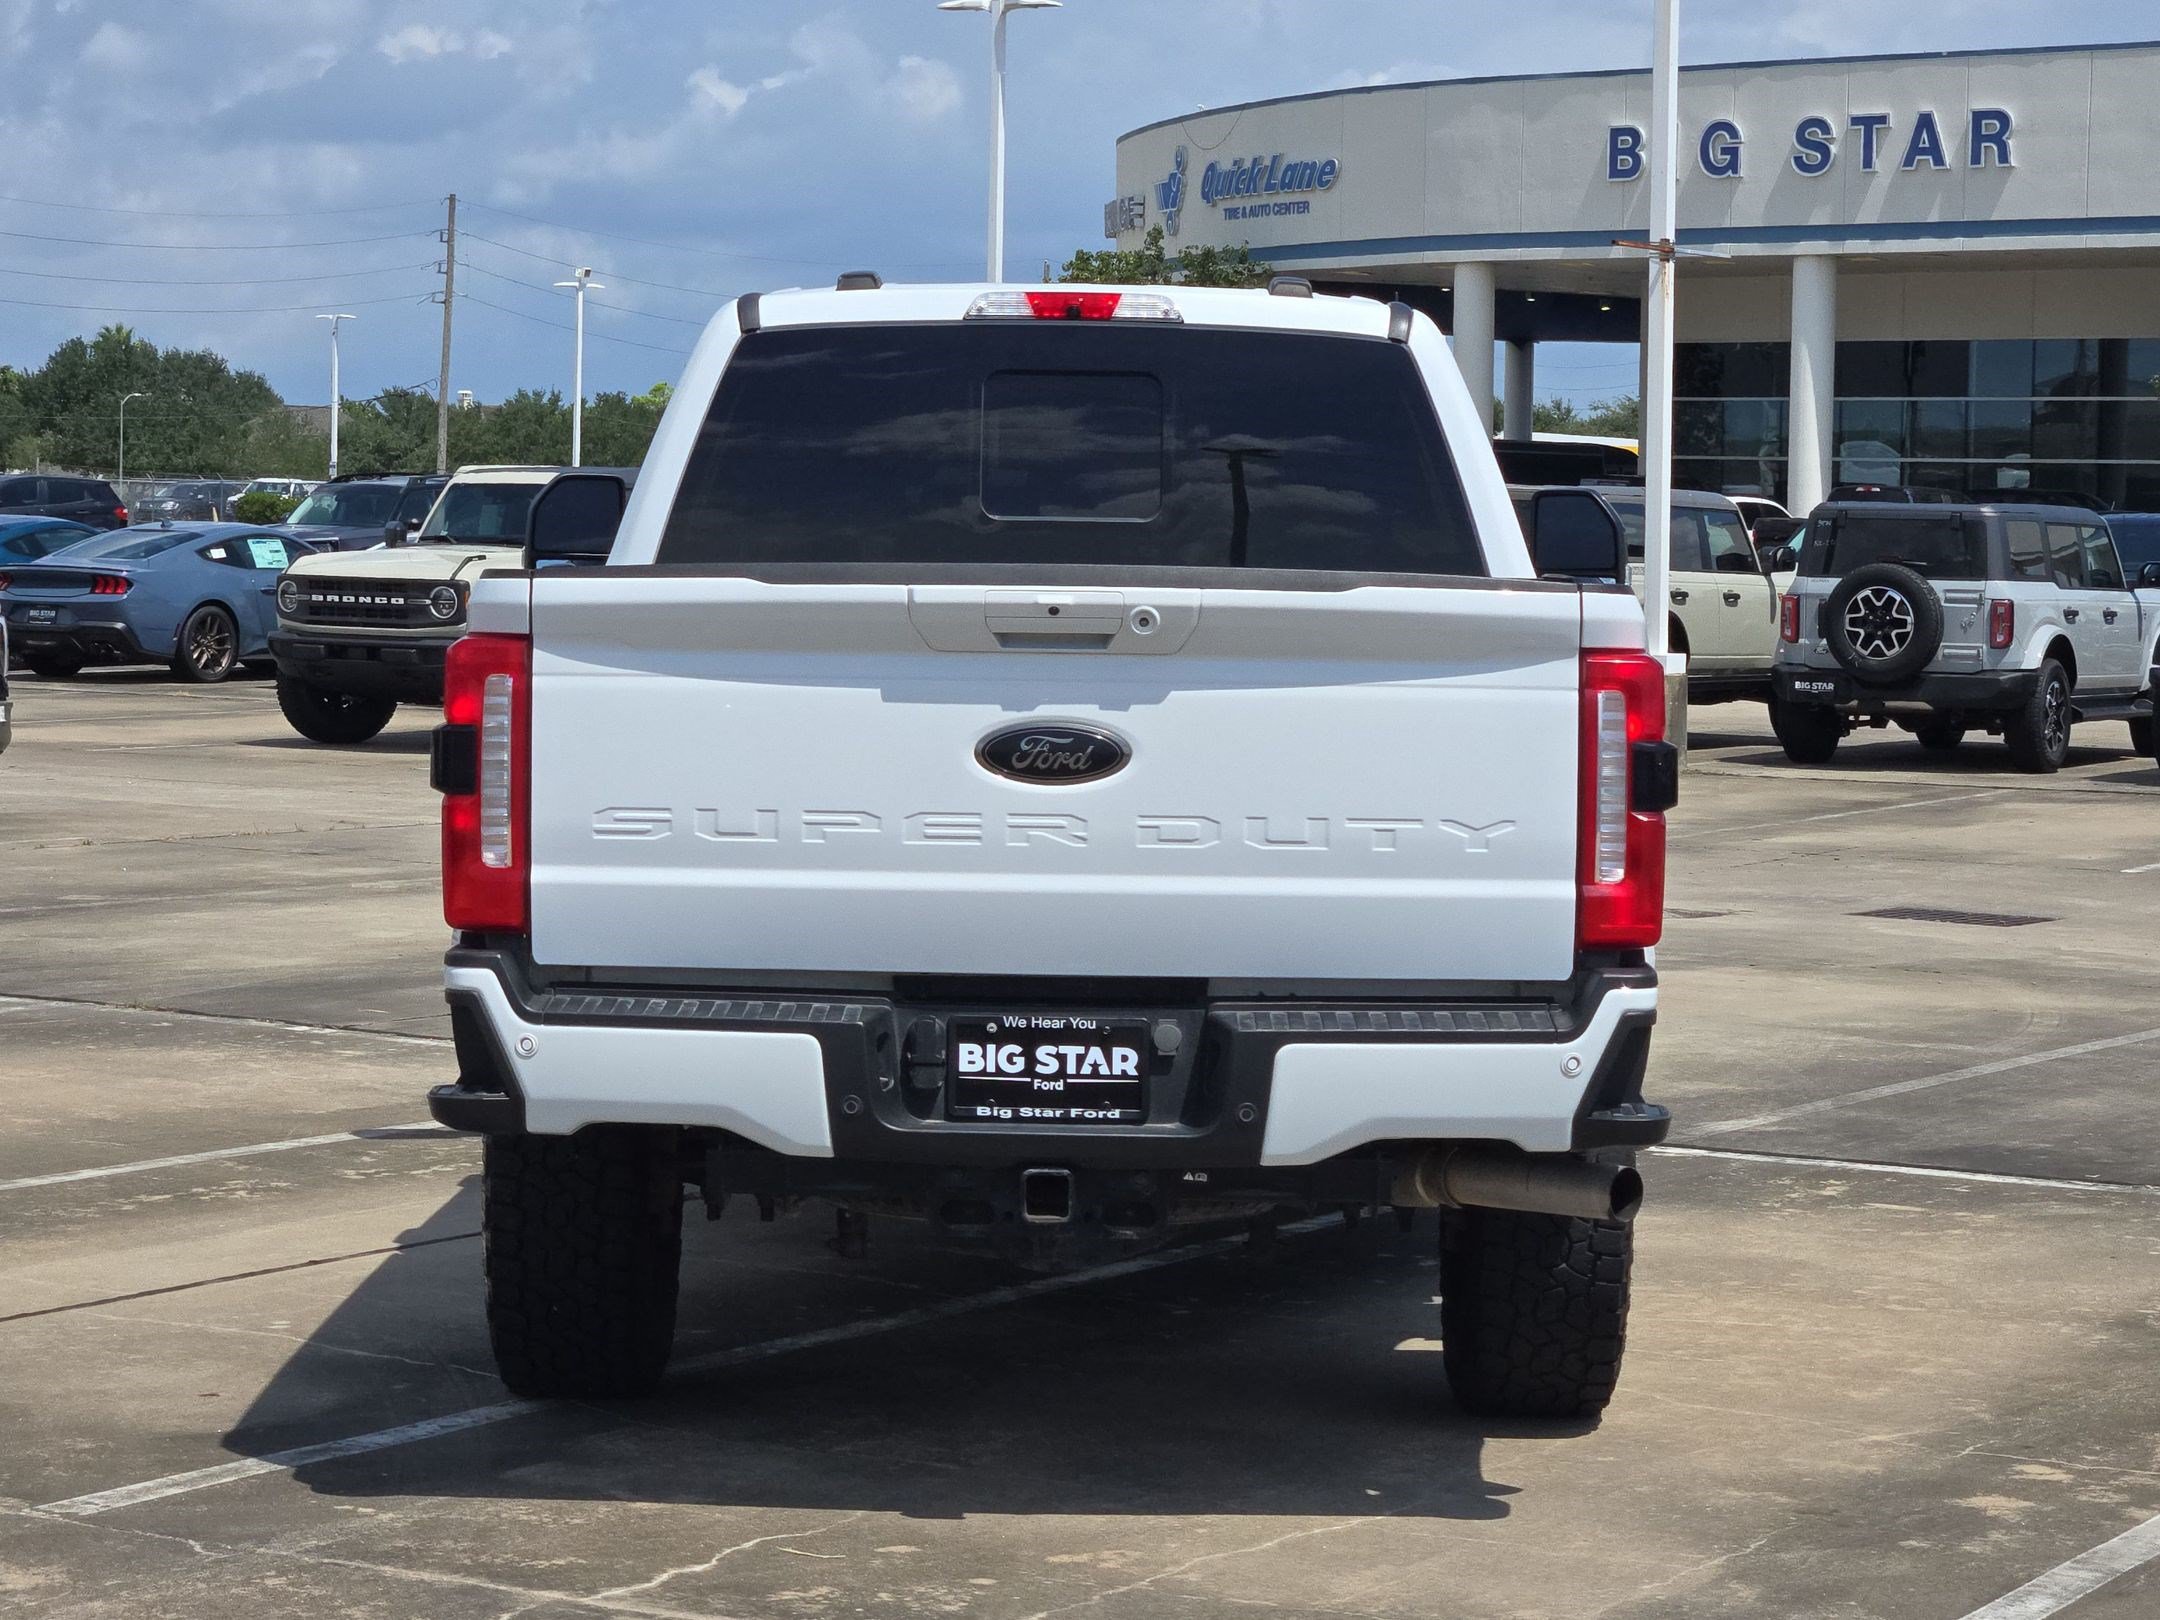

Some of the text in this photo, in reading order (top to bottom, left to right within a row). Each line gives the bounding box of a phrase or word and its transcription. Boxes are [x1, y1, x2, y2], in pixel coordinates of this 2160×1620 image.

[1608, 108, 2015, 182] BG STAR
[1201, 152, 1339, 206] Quick Lane
[1223, 206, 1240, 220] TIRE
[1248, 203, 1271, 218] AUTO
[1272, 201, 1310, 216] CENTER
[311, 594, 404, 605] BRONCO
[1795, 681, 1834, 690] BIG STAR
[1011, 735, 1094, 770] Ford
[592, 806, 1517, 853] SUPER DUTY
[1003, 1016, 1096, 1029] We Hear You
[958, 1043, 1139, 1076] BIG STAR
[1033, 1079, 1064, 1091] Ford
[976, 1106, 1120, 1119] Big Star Ford
